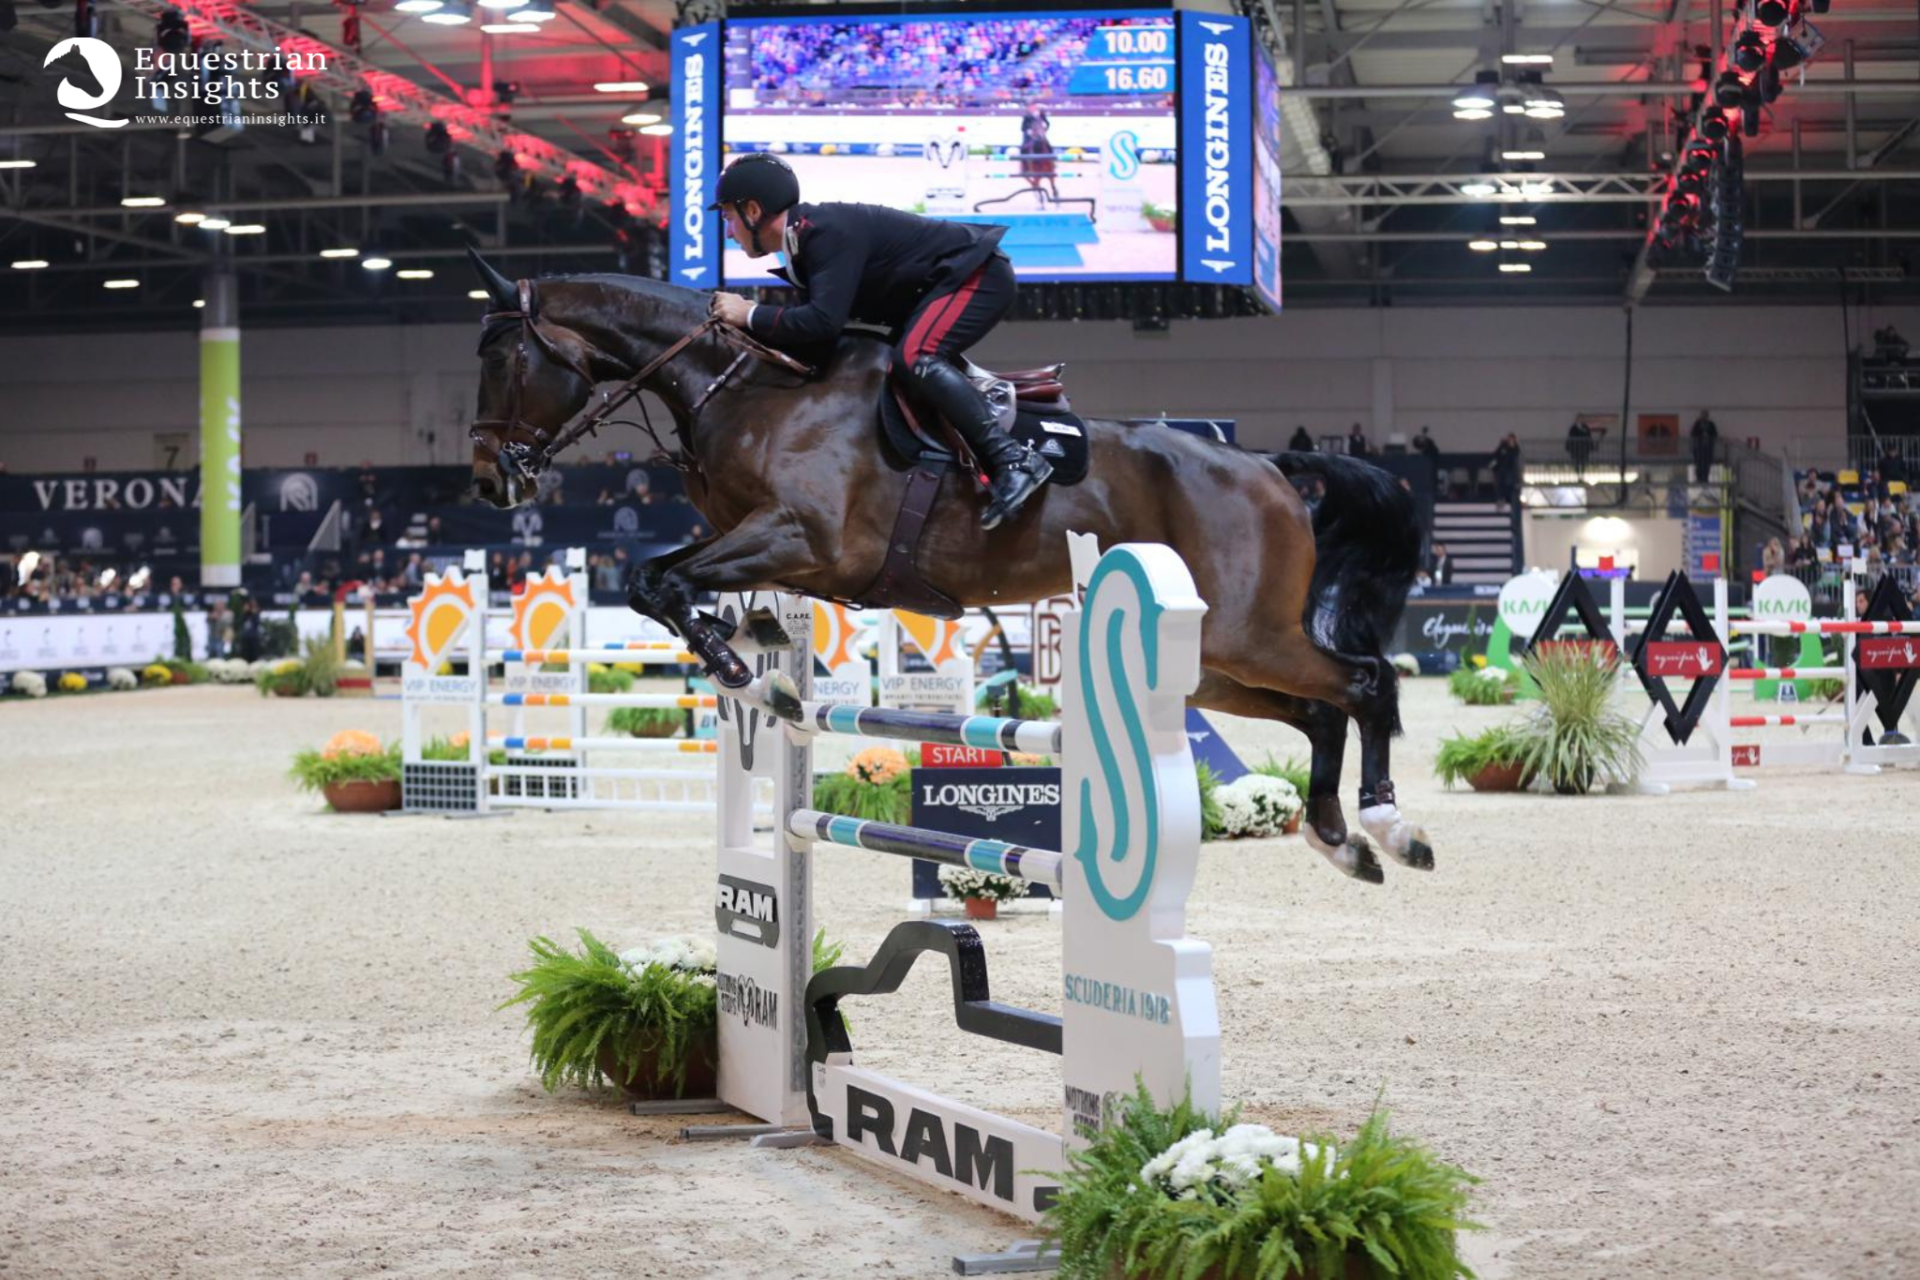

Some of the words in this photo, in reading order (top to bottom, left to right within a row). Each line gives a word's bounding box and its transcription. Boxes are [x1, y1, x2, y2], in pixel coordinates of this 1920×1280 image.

[1105, 31, 1167, 54] 10.00
[1105, 67, 1167, 90] 16.60
[684, 53, 703, 260] LONGINES
[1205, 43, 1230, 252] LONGINES
[1758, 599, 1808, 613] KASK
[404, 678, 425, 692] VIP
[429, 679, 477, 693] ENERGY
[507, 676, 527, 688] VIP
[531, 676, 577, 689] ENERGY
[814, 681, 860, 696] NERGY
[881, 678, 905, 691] VIP
[910, 677, 963, 692] ENERGY
[932, 747, 987, 763] START
[923, 784, 1060, 806] LONGINES
[716, 883, 774, 923] RAM
[755, 985, 778, 1031] RAM
[1065, 974, 1136, 1017] SCUDERIA
[1140, 991, 1170, 1024] 1918
[1064, 1085, 1100, 1118] NOTHING
[847, 1084, 1014, 1203] RAM
